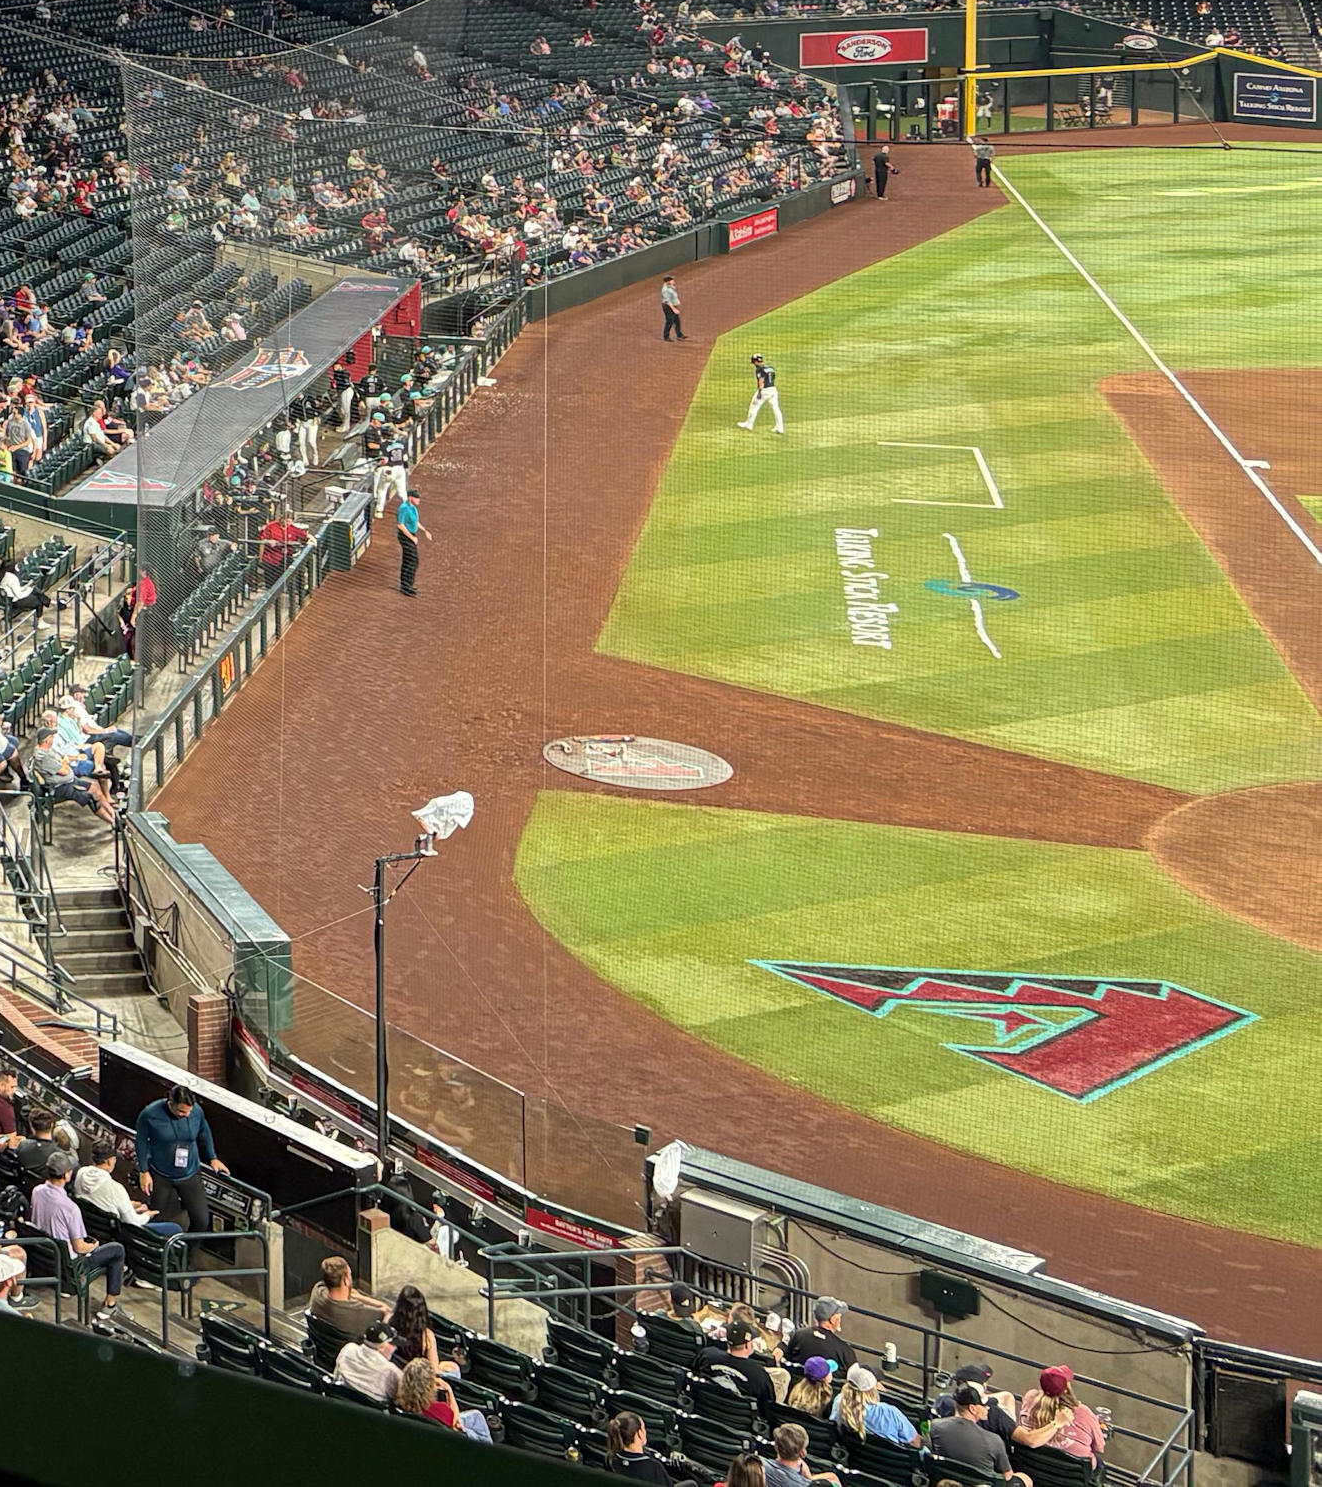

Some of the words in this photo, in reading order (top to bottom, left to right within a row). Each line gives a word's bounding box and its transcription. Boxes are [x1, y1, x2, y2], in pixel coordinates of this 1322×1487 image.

[841, 38, 888, 52] SANDERSON
[853, 45, 875, 58] Ford
[835, 528, 878, 568] TALKING
[841, 569, 889, 600] STICK
[846, 602, 899, 649] RESORT
